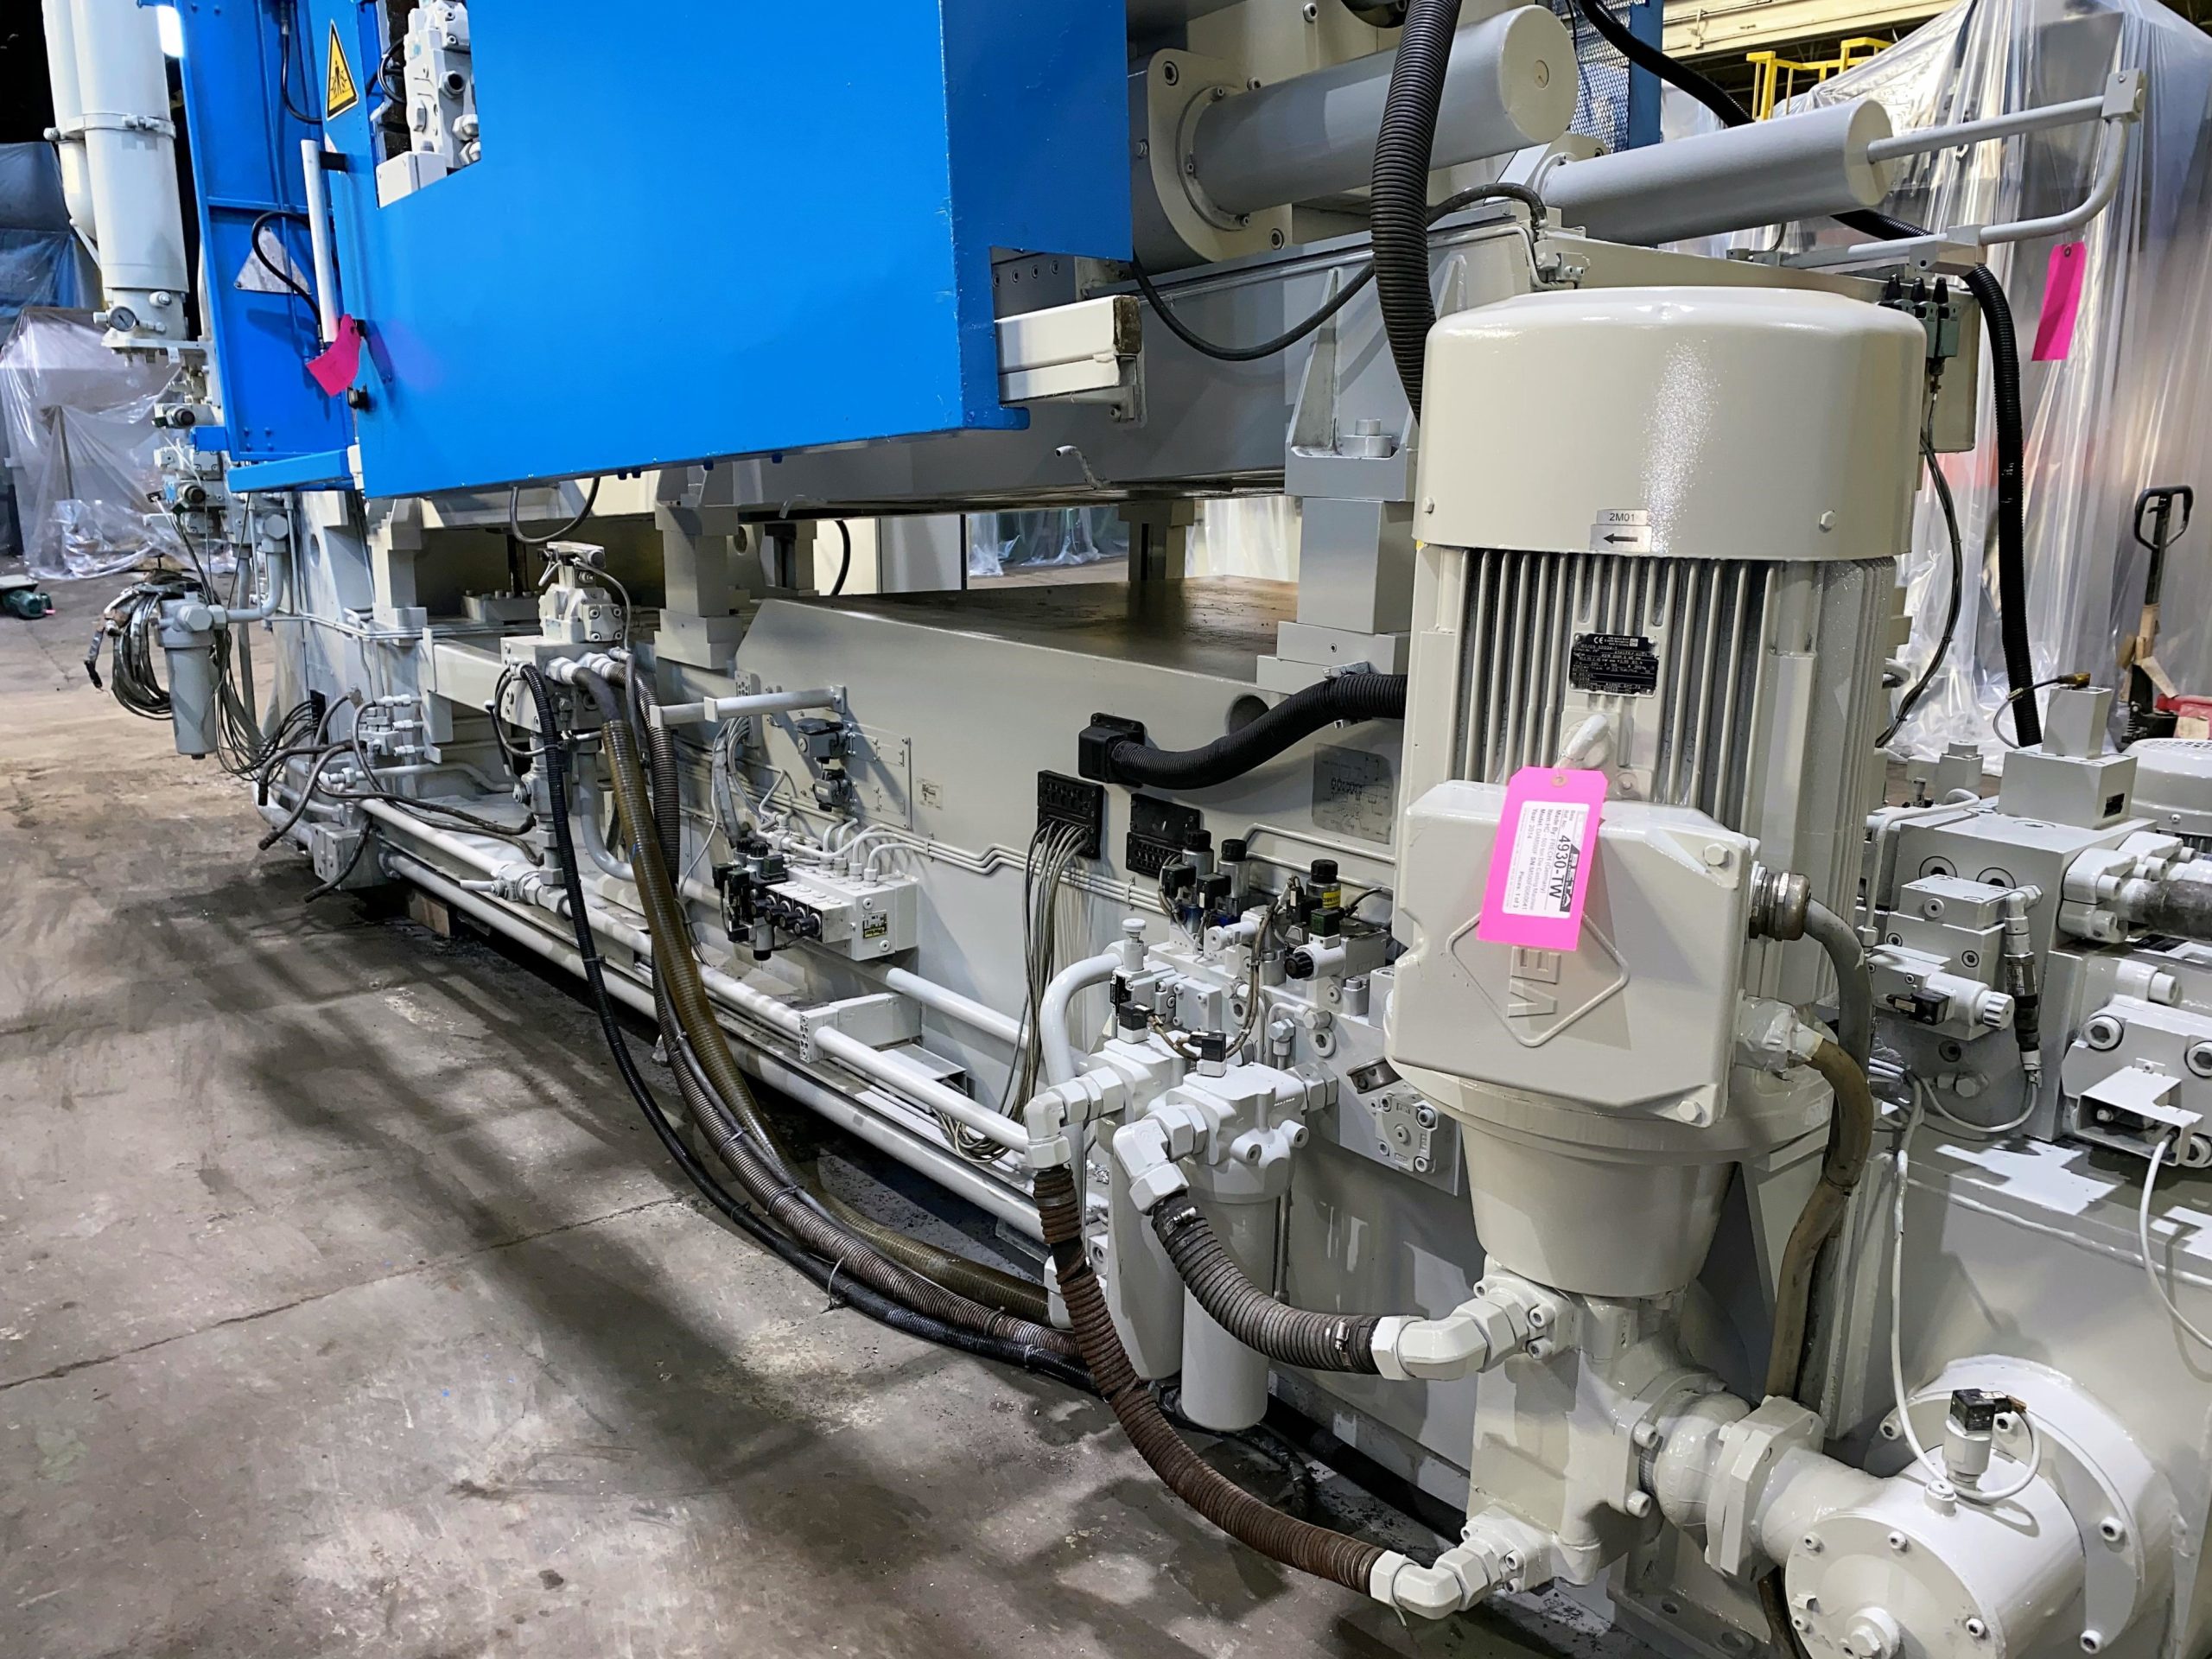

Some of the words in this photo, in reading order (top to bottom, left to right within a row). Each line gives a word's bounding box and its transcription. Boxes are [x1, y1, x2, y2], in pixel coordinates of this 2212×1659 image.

[1609, 512, 1635, 522] 2M01
[1548, 835, 1570, 899] 4930-TW
[1508, 946, 1561, 1018] VE
